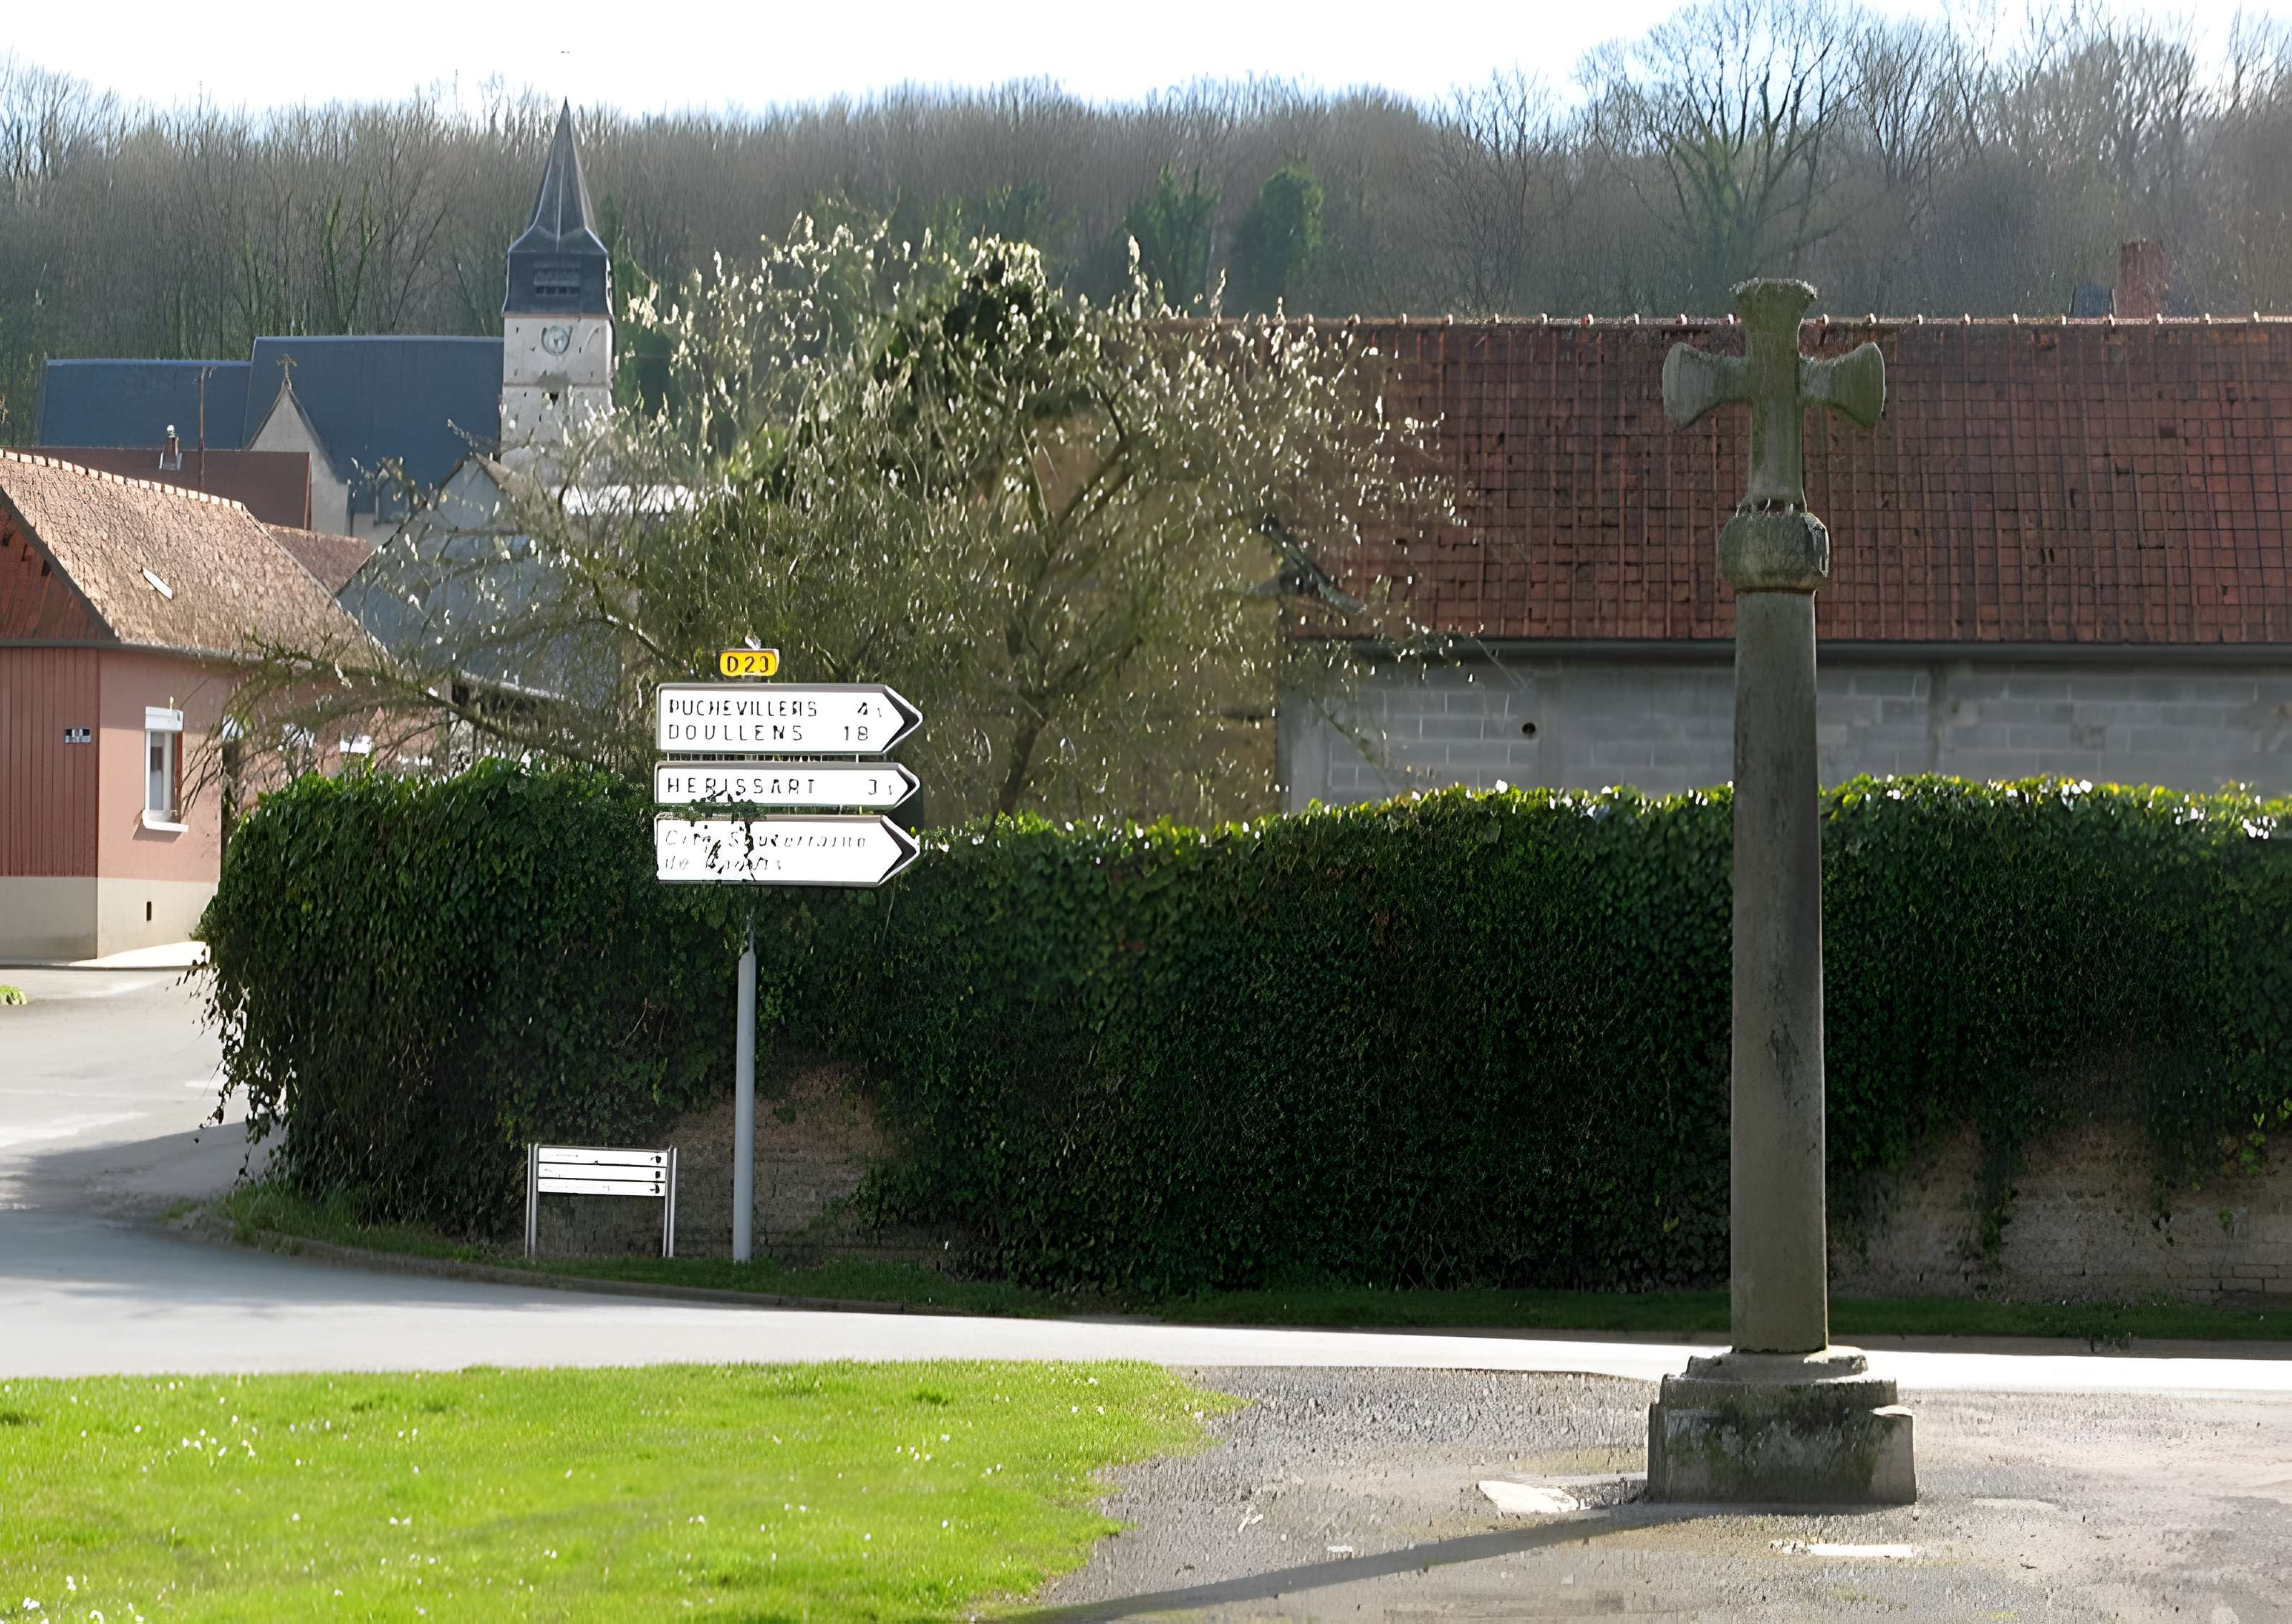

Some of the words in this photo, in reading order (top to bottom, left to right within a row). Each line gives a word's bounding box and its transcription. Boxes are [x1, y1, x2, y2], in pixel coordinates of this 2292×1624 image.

[668, 724, 803, 741] DOULLENS
[844, 725, 869, 741] 18
[668, 778, 814, 795] HERISSART
